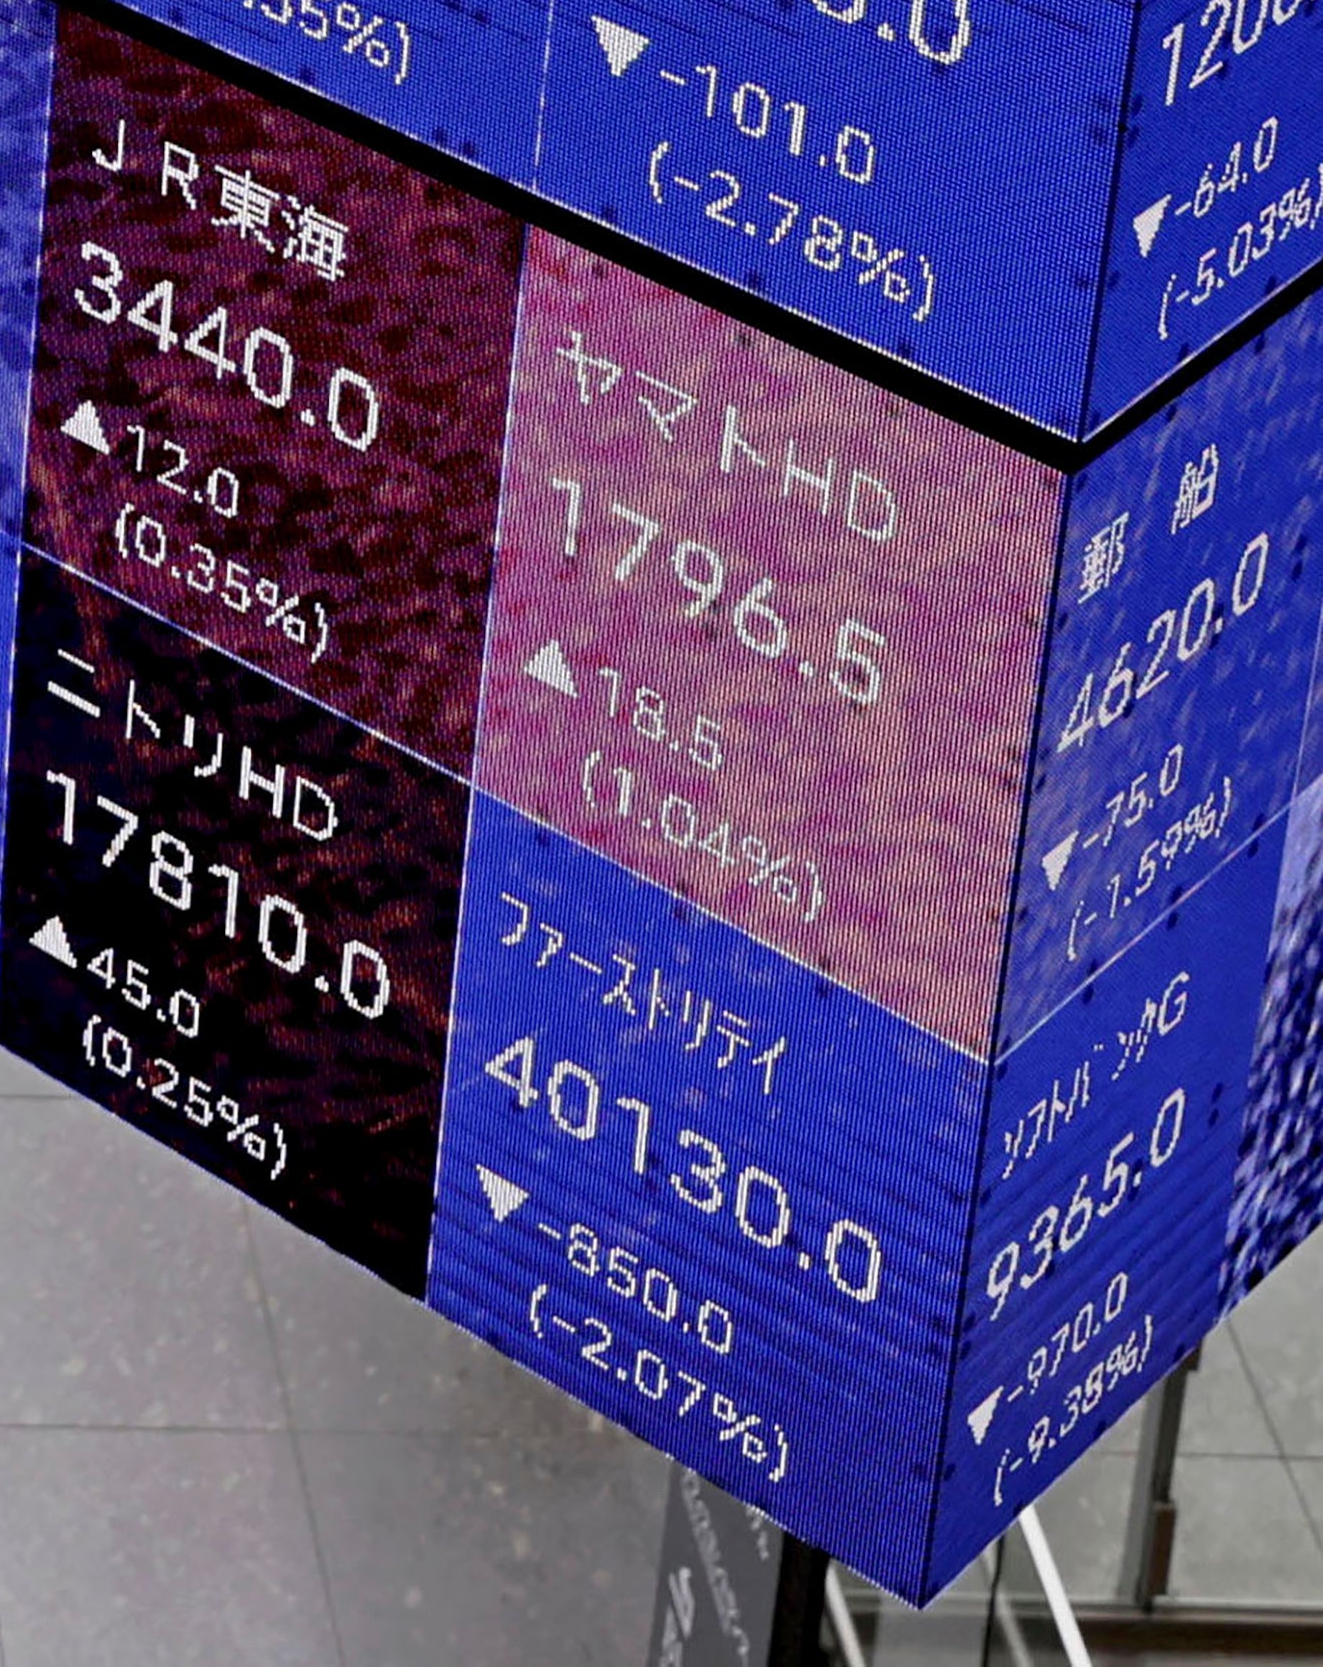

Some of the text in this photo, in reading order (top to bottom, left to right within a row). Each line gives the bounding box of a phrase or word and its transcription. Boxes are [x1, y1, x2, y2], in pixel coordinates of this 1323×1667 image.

[648, 141, 935, 322] (-2.78%)
[1173, 116, 1279, 225] -64.0
[73, 241, 381, 453] 3440.0
[555, 328, 896, 542] ヤマトHD
[1058, 533, 1267, 752] 4620.0
[47, 649, 340, 842] ニトリHD
[1081, 745, 1183, 852] -75.0
[45, 770, 392, 1020] 17810.0
[1066, 778, 1232, 959] (-1.59%)
[484, 1037, 882, 1303] 40130.0
[985, 1091, 1185, 1320] 9365.0
[529, 1284, 789, 1483] (-2.07%)
[994, 1315, 1153, 1506] (-9.38%)
[1008, 1271, 1129, 1403] -970.0
